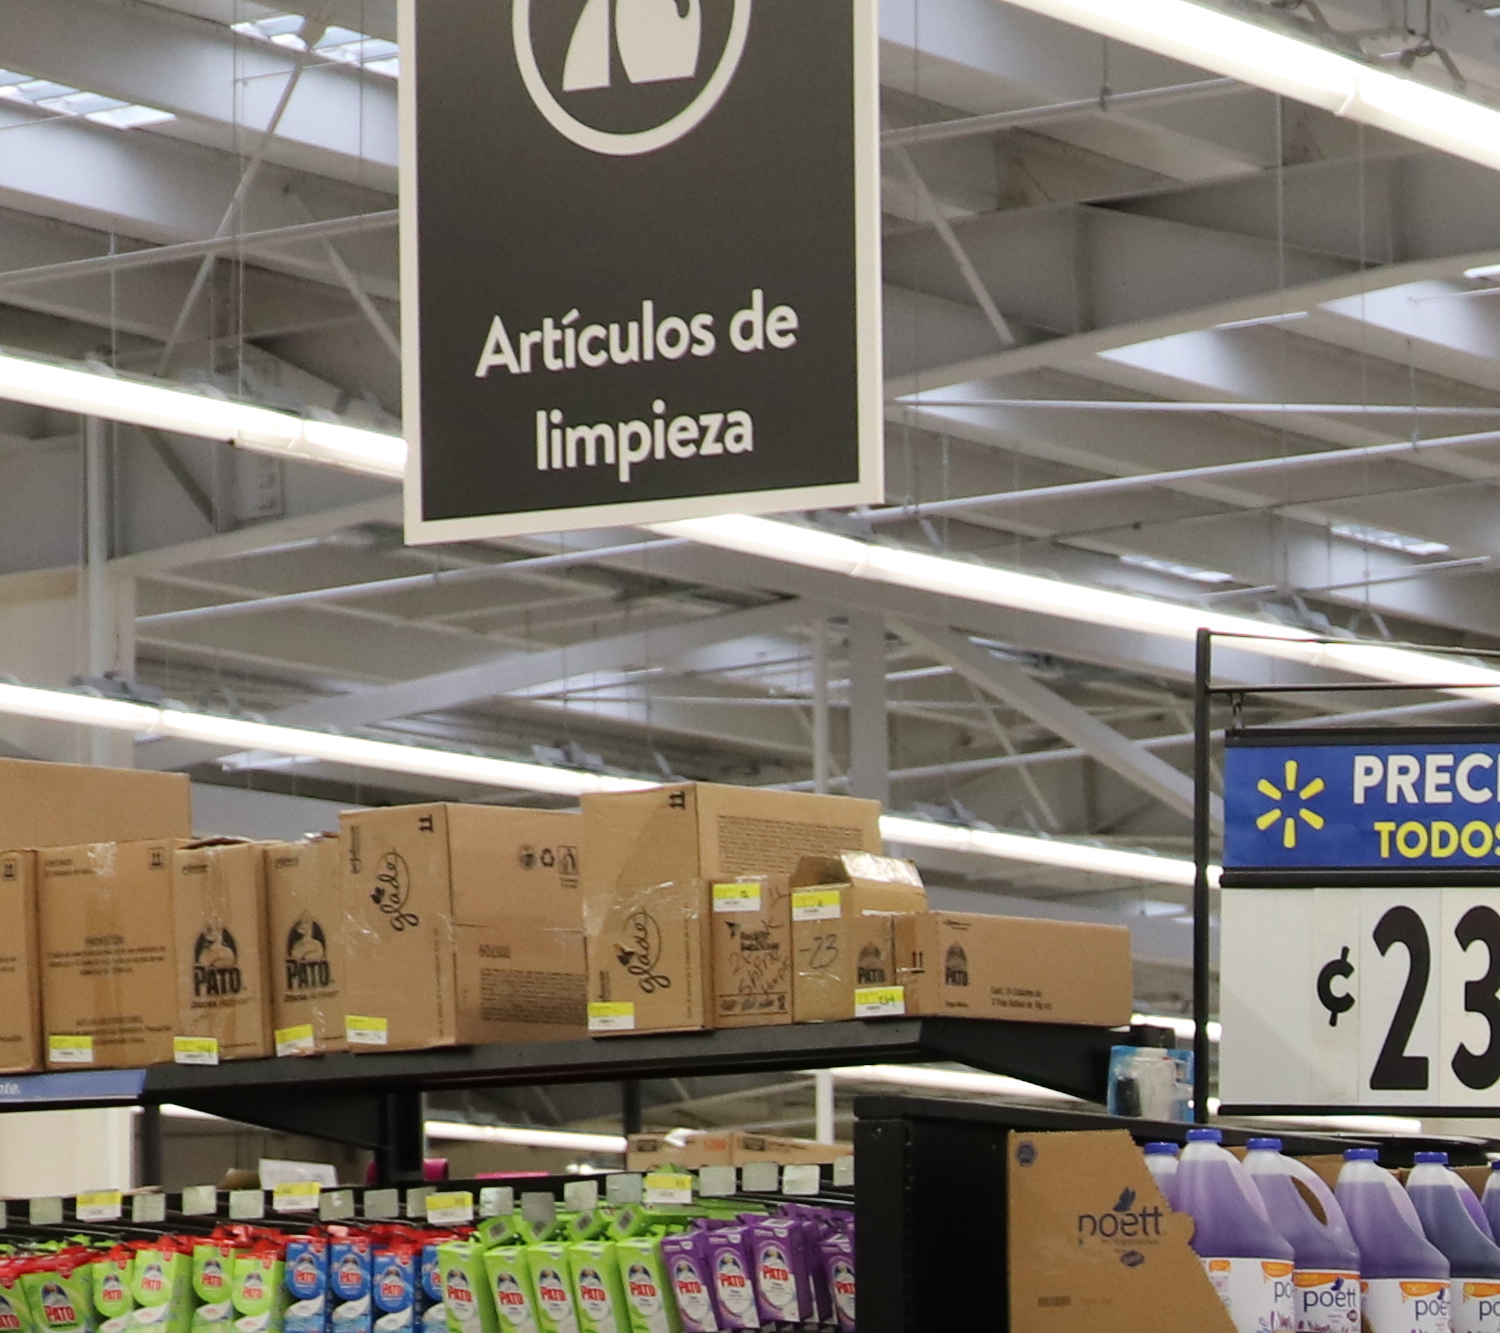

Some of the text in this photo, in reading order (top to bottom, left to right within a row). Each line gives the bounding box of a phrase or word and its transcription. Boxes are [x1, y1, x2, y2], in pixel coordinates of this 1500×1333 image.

[476, 289, 798, 378] Artículos de
[536, 400, 754, 482] limpieza
[286, 959, 329, 989] PATO
[1078, 1205, 1164, 1247] poett
